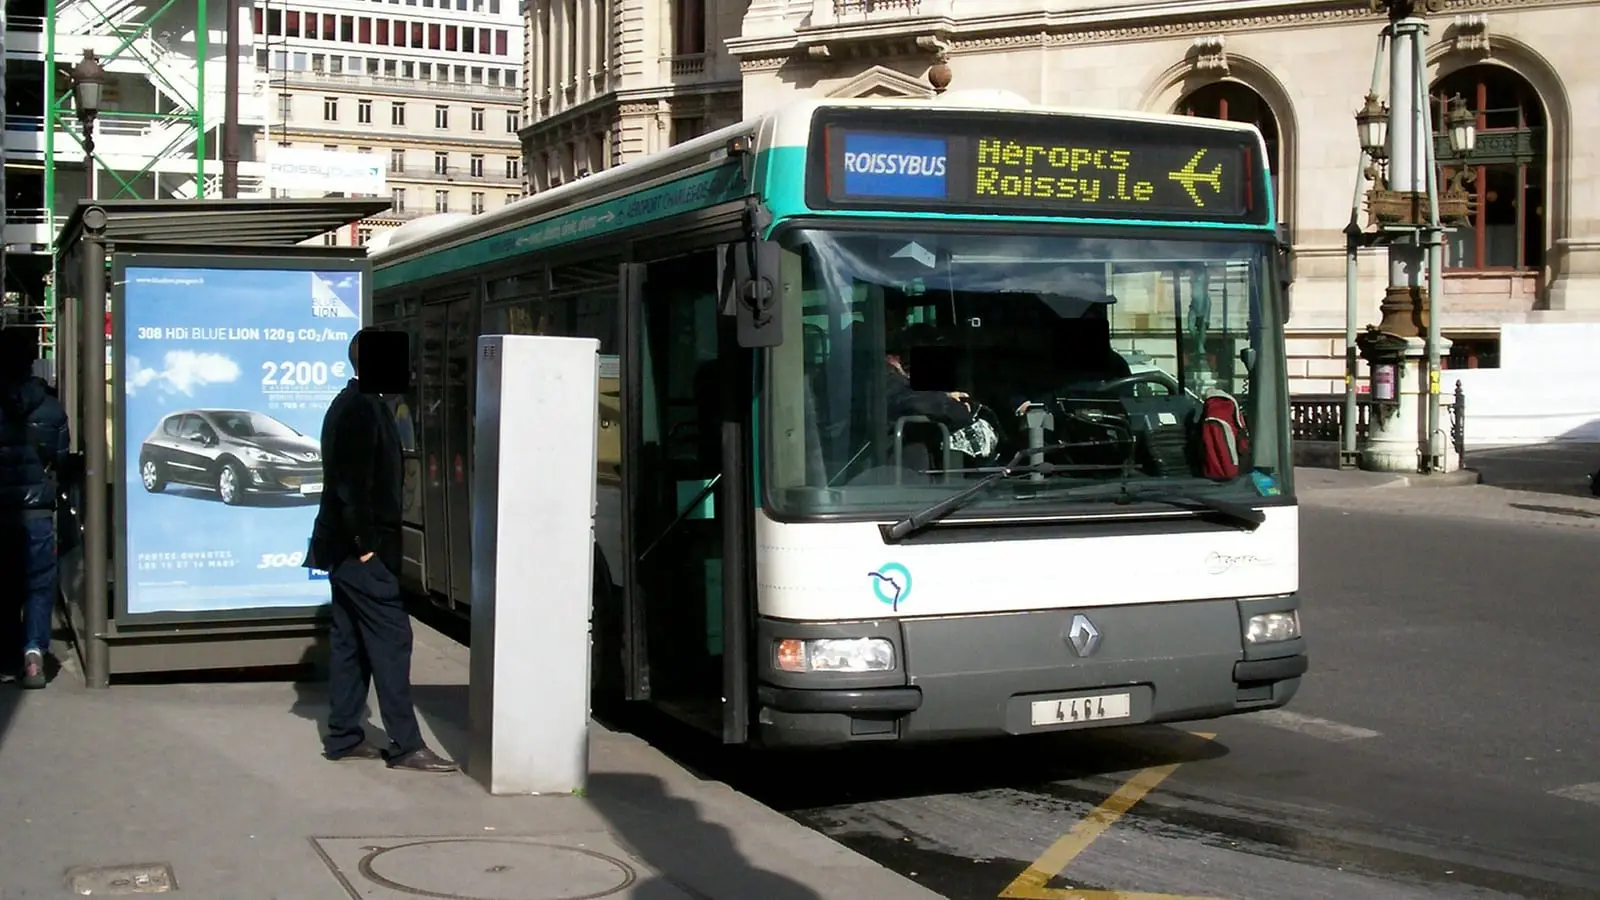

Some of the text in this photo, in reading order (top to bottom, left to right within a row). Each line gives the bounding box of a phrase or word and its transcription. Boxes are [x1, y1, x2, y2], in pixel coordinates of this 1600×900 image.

[844, 152, 947, 177] ROISSYBUS
[976, 166, 1101, 203] Roissy
[312, 298, 338, 306] BLUE
[312, 307, 338, 317] LION
[138, 328, 162, 340] 308
[165, 328, 188, 340] HDi
[192, 328, 226, 340] BLUE
[228, 328, 260, 341] LION
[257, 551, 303, 569] 308
[1056, 697, 1105, 721] 4464
